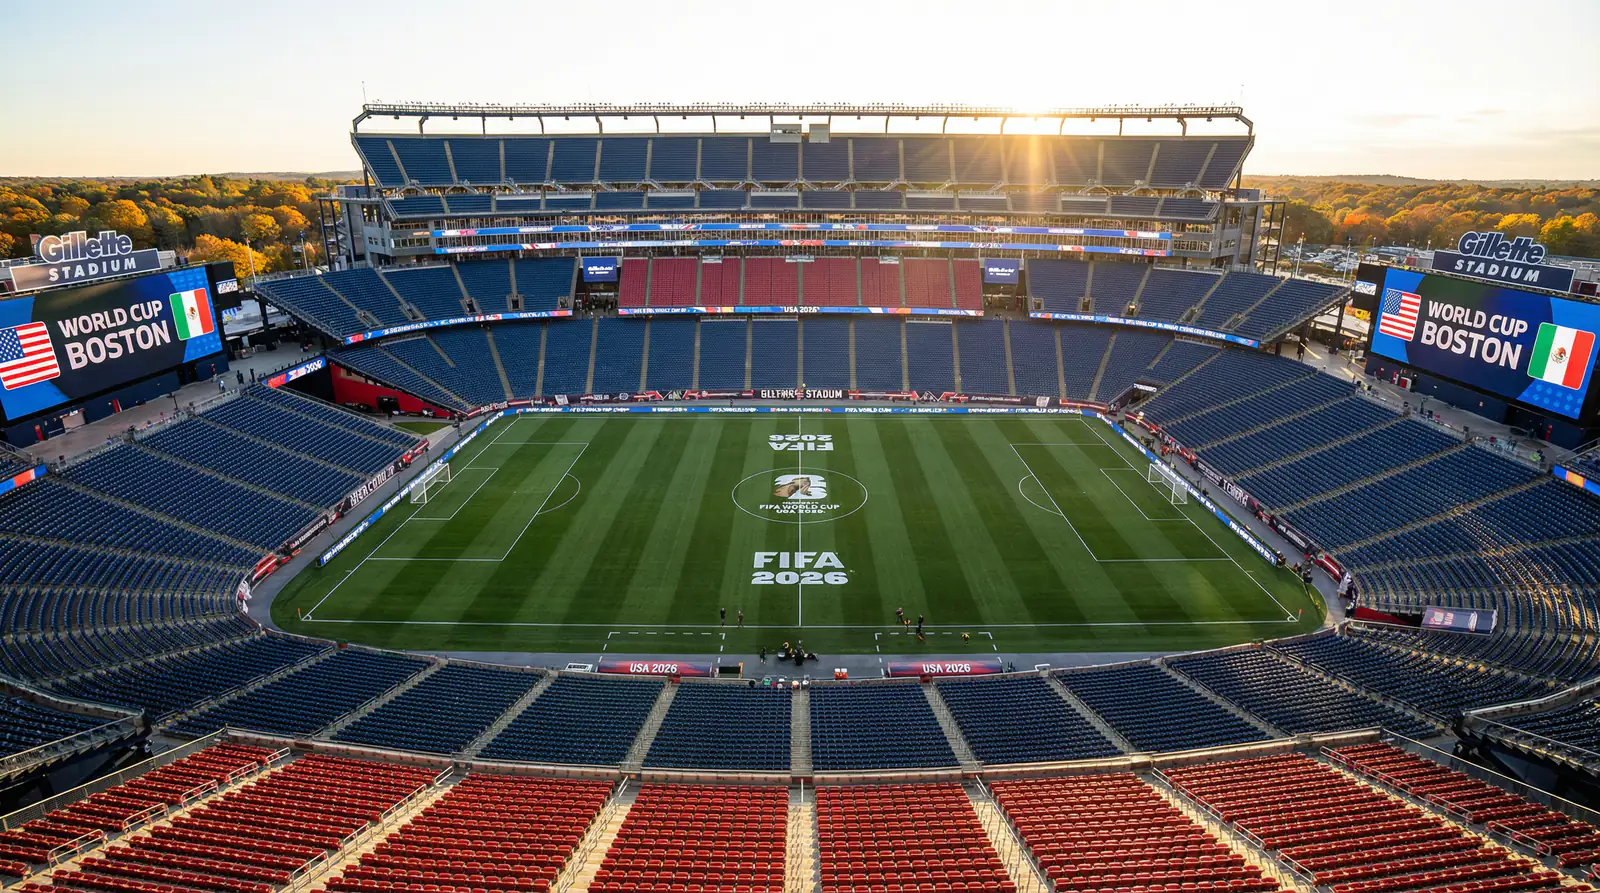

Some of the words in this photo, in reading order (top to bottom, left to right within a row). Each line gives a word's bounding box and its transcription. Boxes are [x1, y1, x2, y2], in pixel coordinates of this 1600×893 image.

[39, 230, 133, 264] Gillette
[1457, 231, 1546, 264] Gillette
[48, 257, 137, 282] STADIUM
[1454, 259, 1541, 283] STADIUM
[57, 307, 128, 338] WORLD
[129, 299, 163, 322] CUP
[1428, 300, 1487, 330] WORLD
[1488, 314, 1529, 338] CUP
[64, 320, 171, 371] BOSTON
[1420, 320, 1523, 370] BOSTON
[768, 442, 834, 451] FIFA
[753, 551, 845, 569] FIFA
[751, 571, 849, 585] 2026
[629, 663, 650, 673] USA
[652, 663, 678, 674] 2026
[922, 663, 943, 674] USA
[945, 663, 971, 673] 2026
